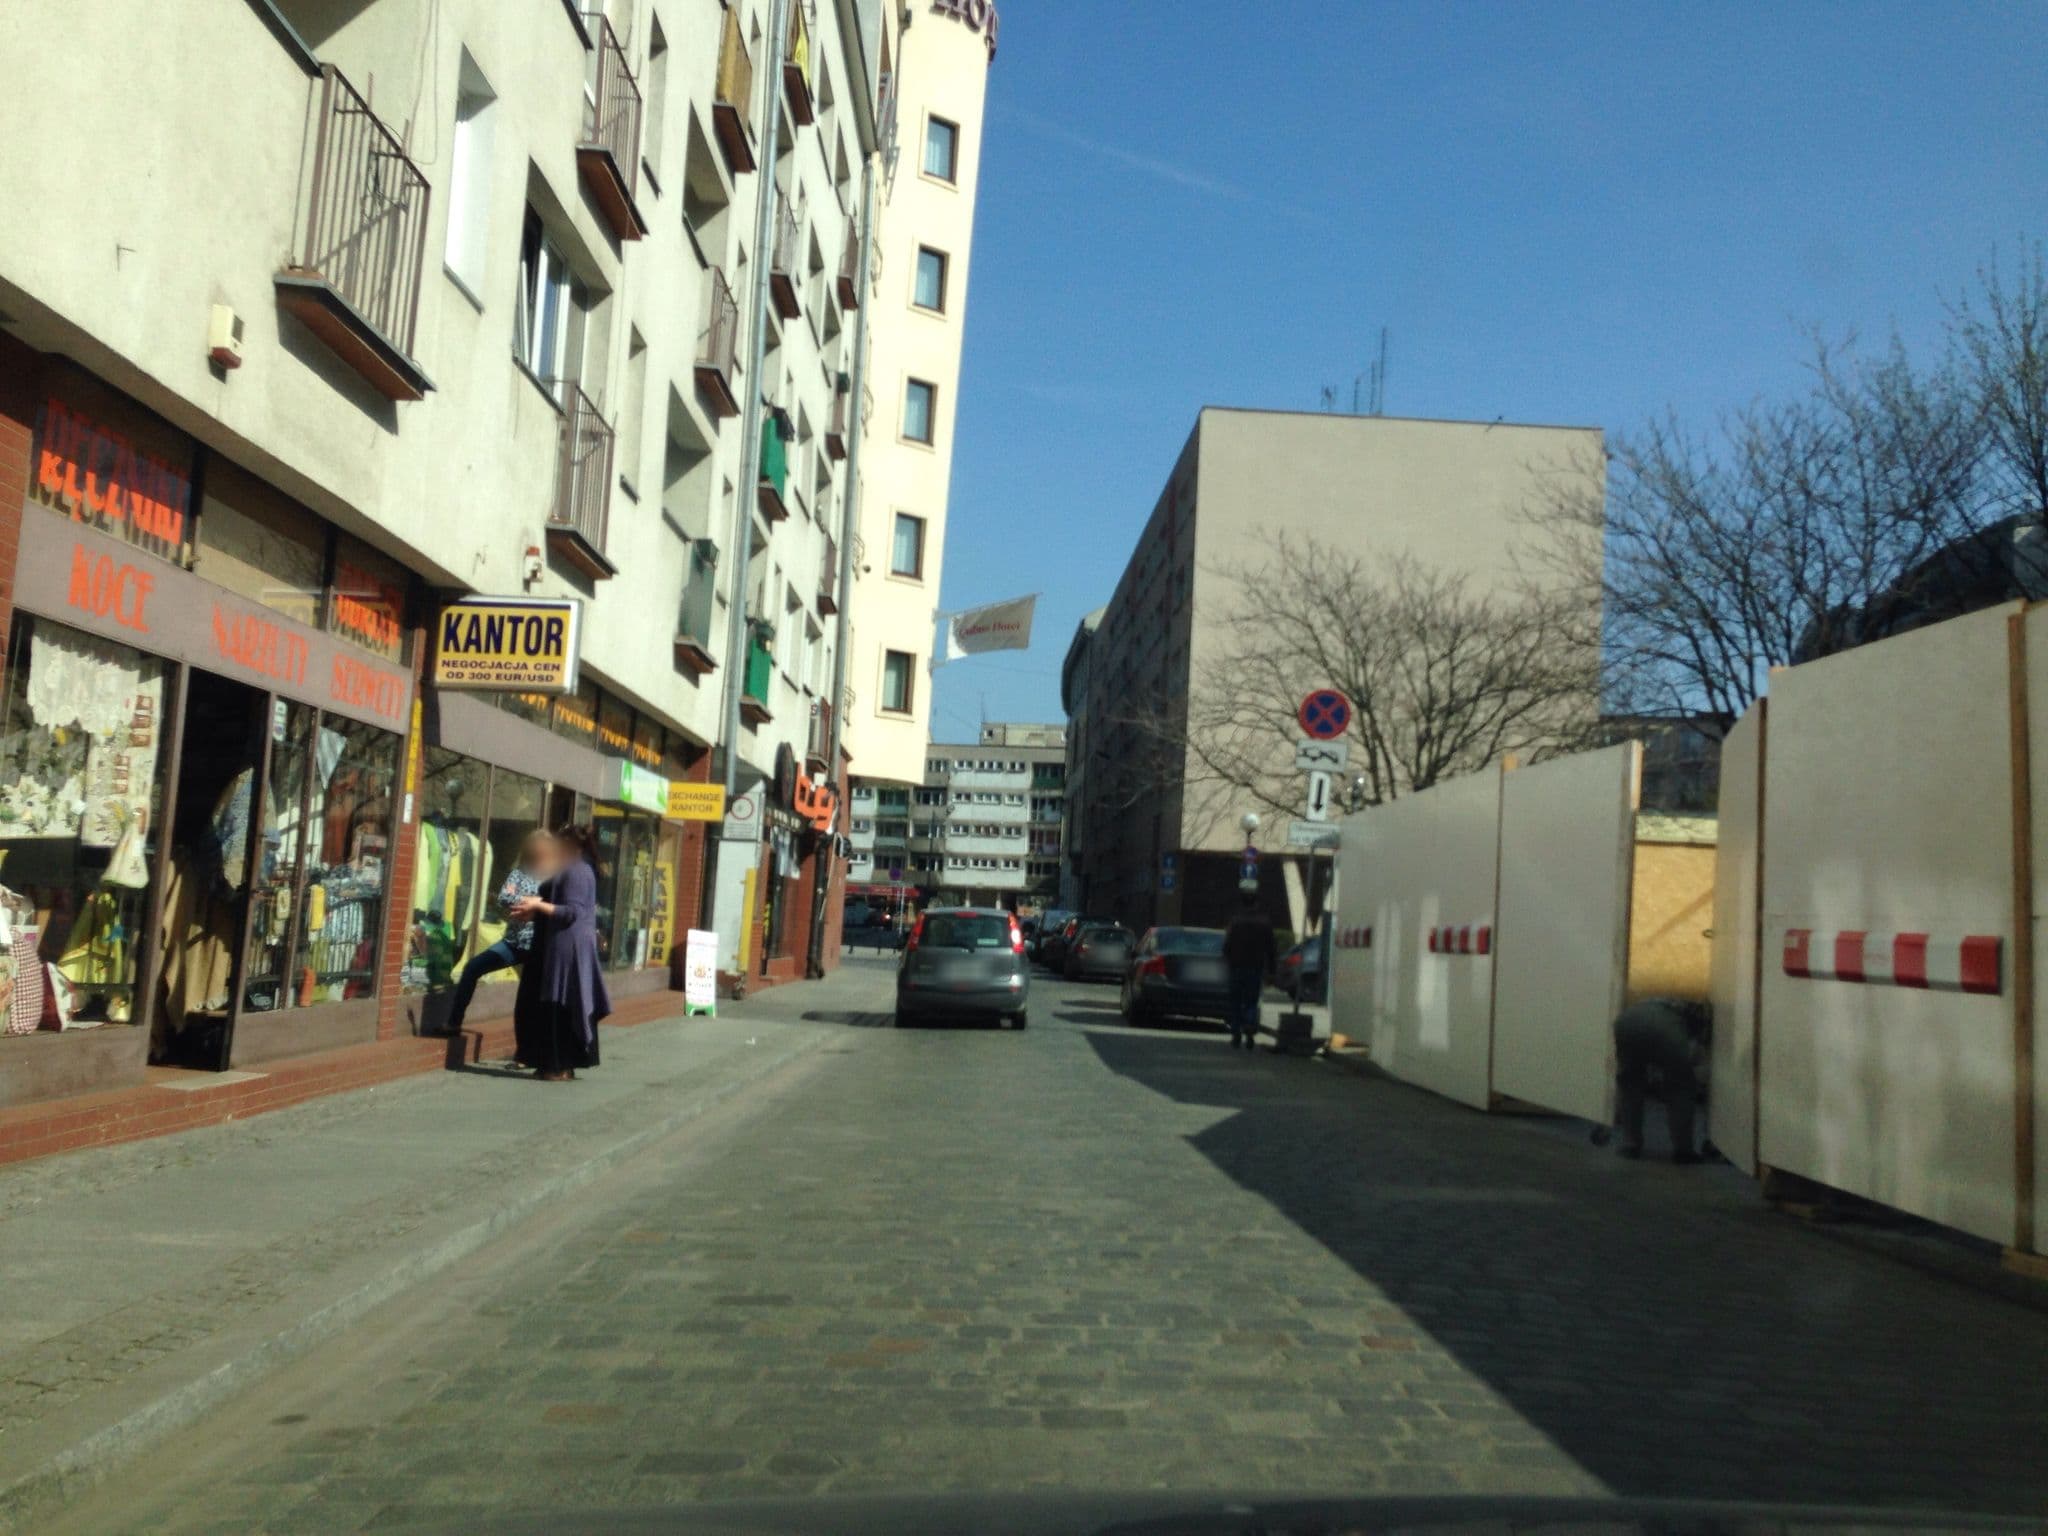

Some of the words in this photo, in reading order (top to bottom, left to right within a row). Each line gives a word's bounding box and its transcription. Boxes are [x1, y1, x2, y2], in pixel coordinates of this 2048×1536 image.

[67, 543, 155, 634] KOCE
[443, 613, 563, 656] KANTOR
[441, 659, 529, 671] NEGOCJACJA
[533, 663, 561, 672] CEN
[446, 671, 465, 680] OD
[468, 672, 491, 681] 300
[495, 673, 555, 683] EUR/USD
